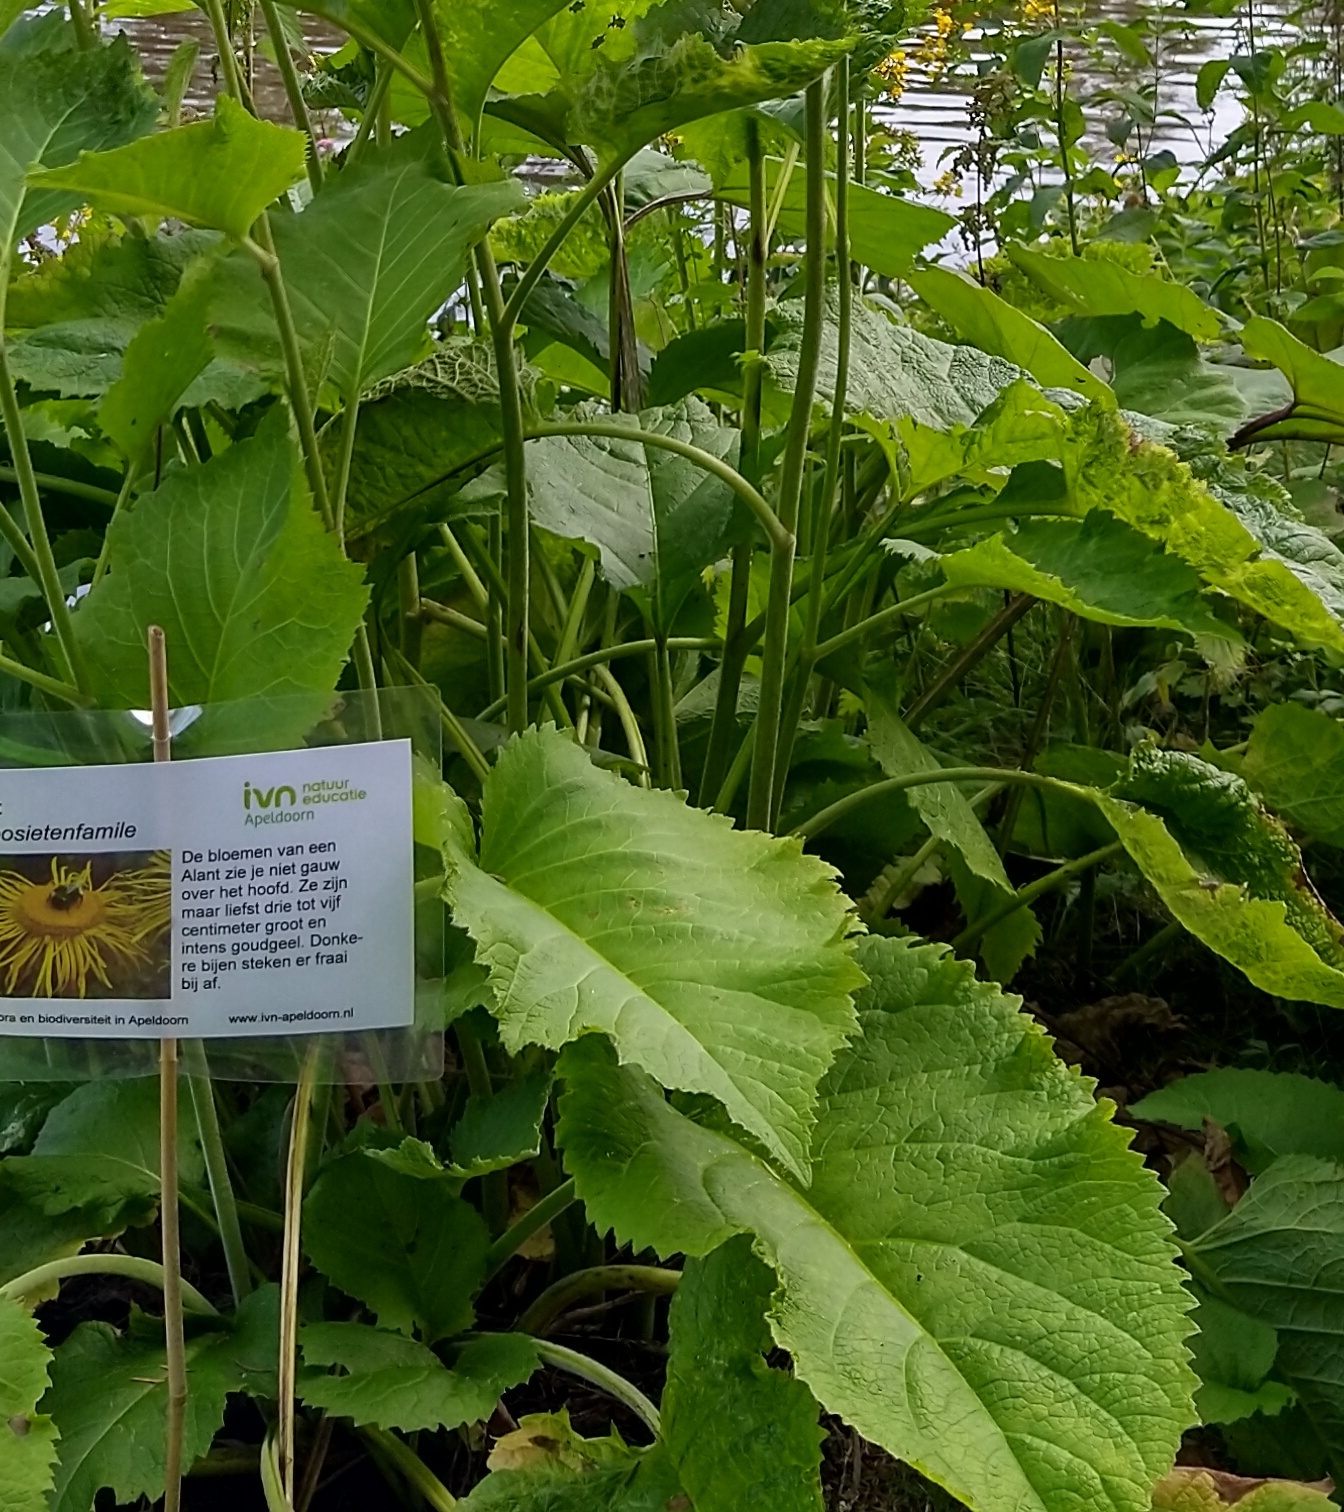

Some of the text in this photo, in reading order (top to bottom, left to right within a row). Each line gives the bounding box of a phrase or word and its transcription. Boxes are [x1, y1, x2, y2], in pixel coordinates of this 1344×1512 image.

[244, 781, 296, 810] ivn
[302, 780, 349, 793] natuur
[302, 789, 367, 805] educatie
[244, 810, 314, 828] Apeldoorn
[182, 841, 336, 863] De bloemen van een
[181, 860, 340, 882] Alant zie je niet gauw
[181, 878, 348, 900] over het hoofd. Ze zijn
[181, 895, 341, 918] maar liefst drie tot vijf
[182, 917, 326, 936] centimeter groot en
[181, 933, 363, 955] intens goudgeel. Donke-
[181, 951, 348, 974] re bijen steken er fraai
[181, 977, 221, 992] bij af.
[20, 1014, 34, 1023] en
[38, 1014, 111, 1024] biodiversiteit
[115, 1015, 125, 1025] in
[129, 1015, 189, 1026] Apeldoorn
[229, 1007, 354, 1024] www.ivn-apeldoorn.nl
